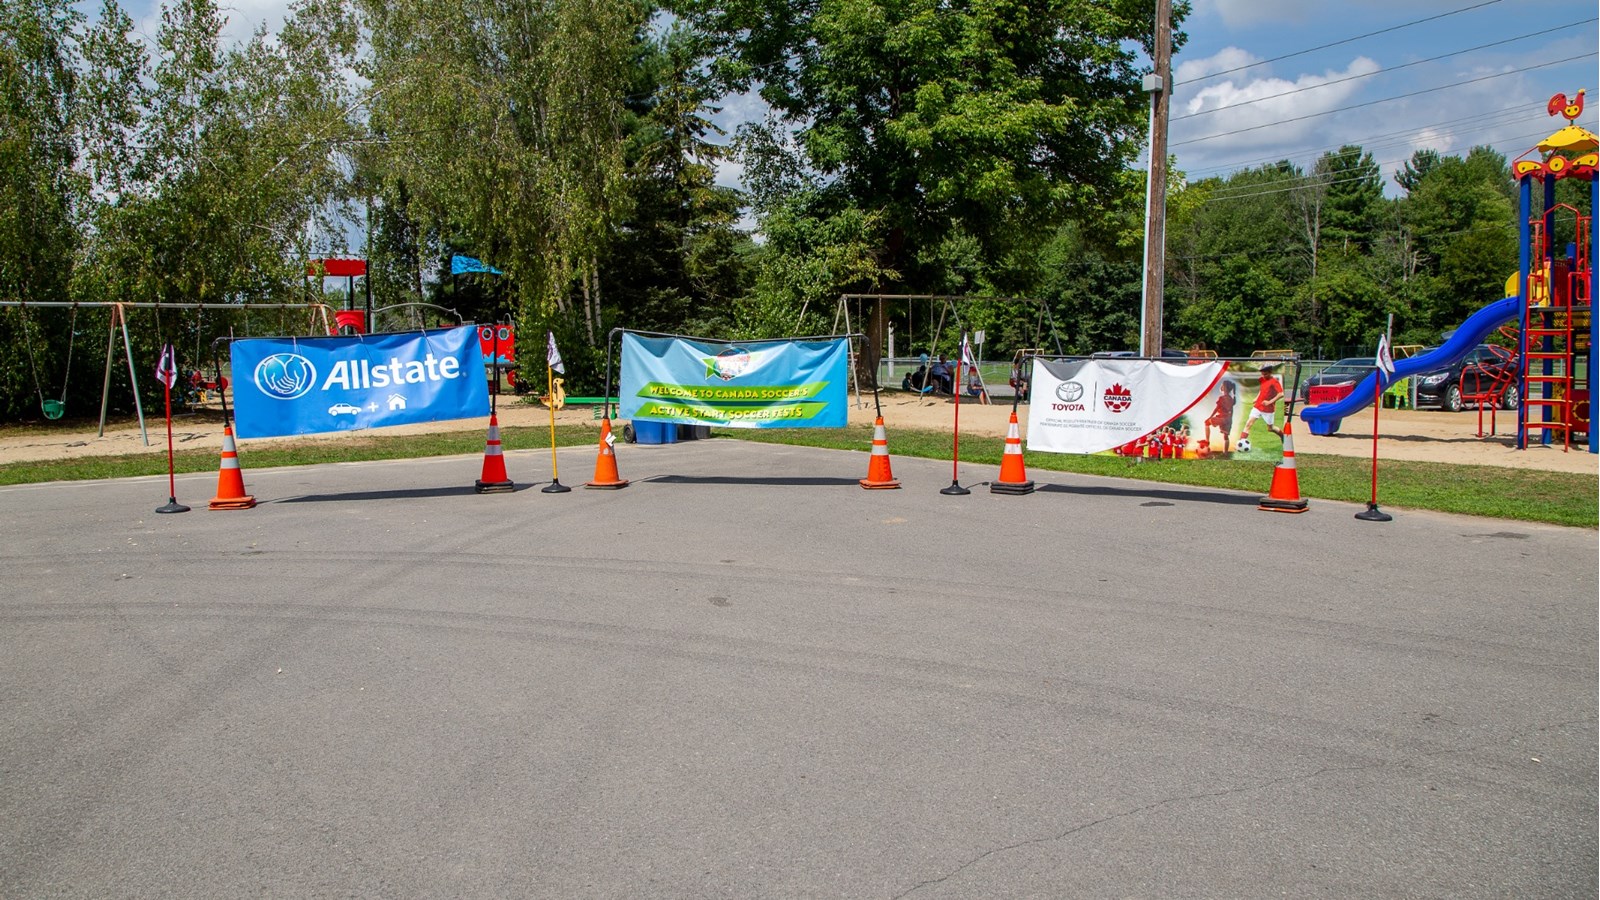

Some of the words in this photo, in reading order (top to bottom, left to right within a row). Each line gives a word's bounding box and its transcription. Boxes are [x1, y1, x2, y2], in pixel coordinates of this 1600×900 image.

[321, 353, 460, 391] Allstate
[650, 386, 698, 398] WELCOME
[700, 389, 714, 398] TO
[715, 389, 759, 399] CANADA
[761, 387, 809, 399] SOCCER'S
[650, 406, 691, 417] ACTIVE
[692, 407, 726, 419] START
[728, 410, 770, 419] SOCCER
[772, 407, 803, 417] FESTS
[1052, 403, 1085, 412] TOYOTA
